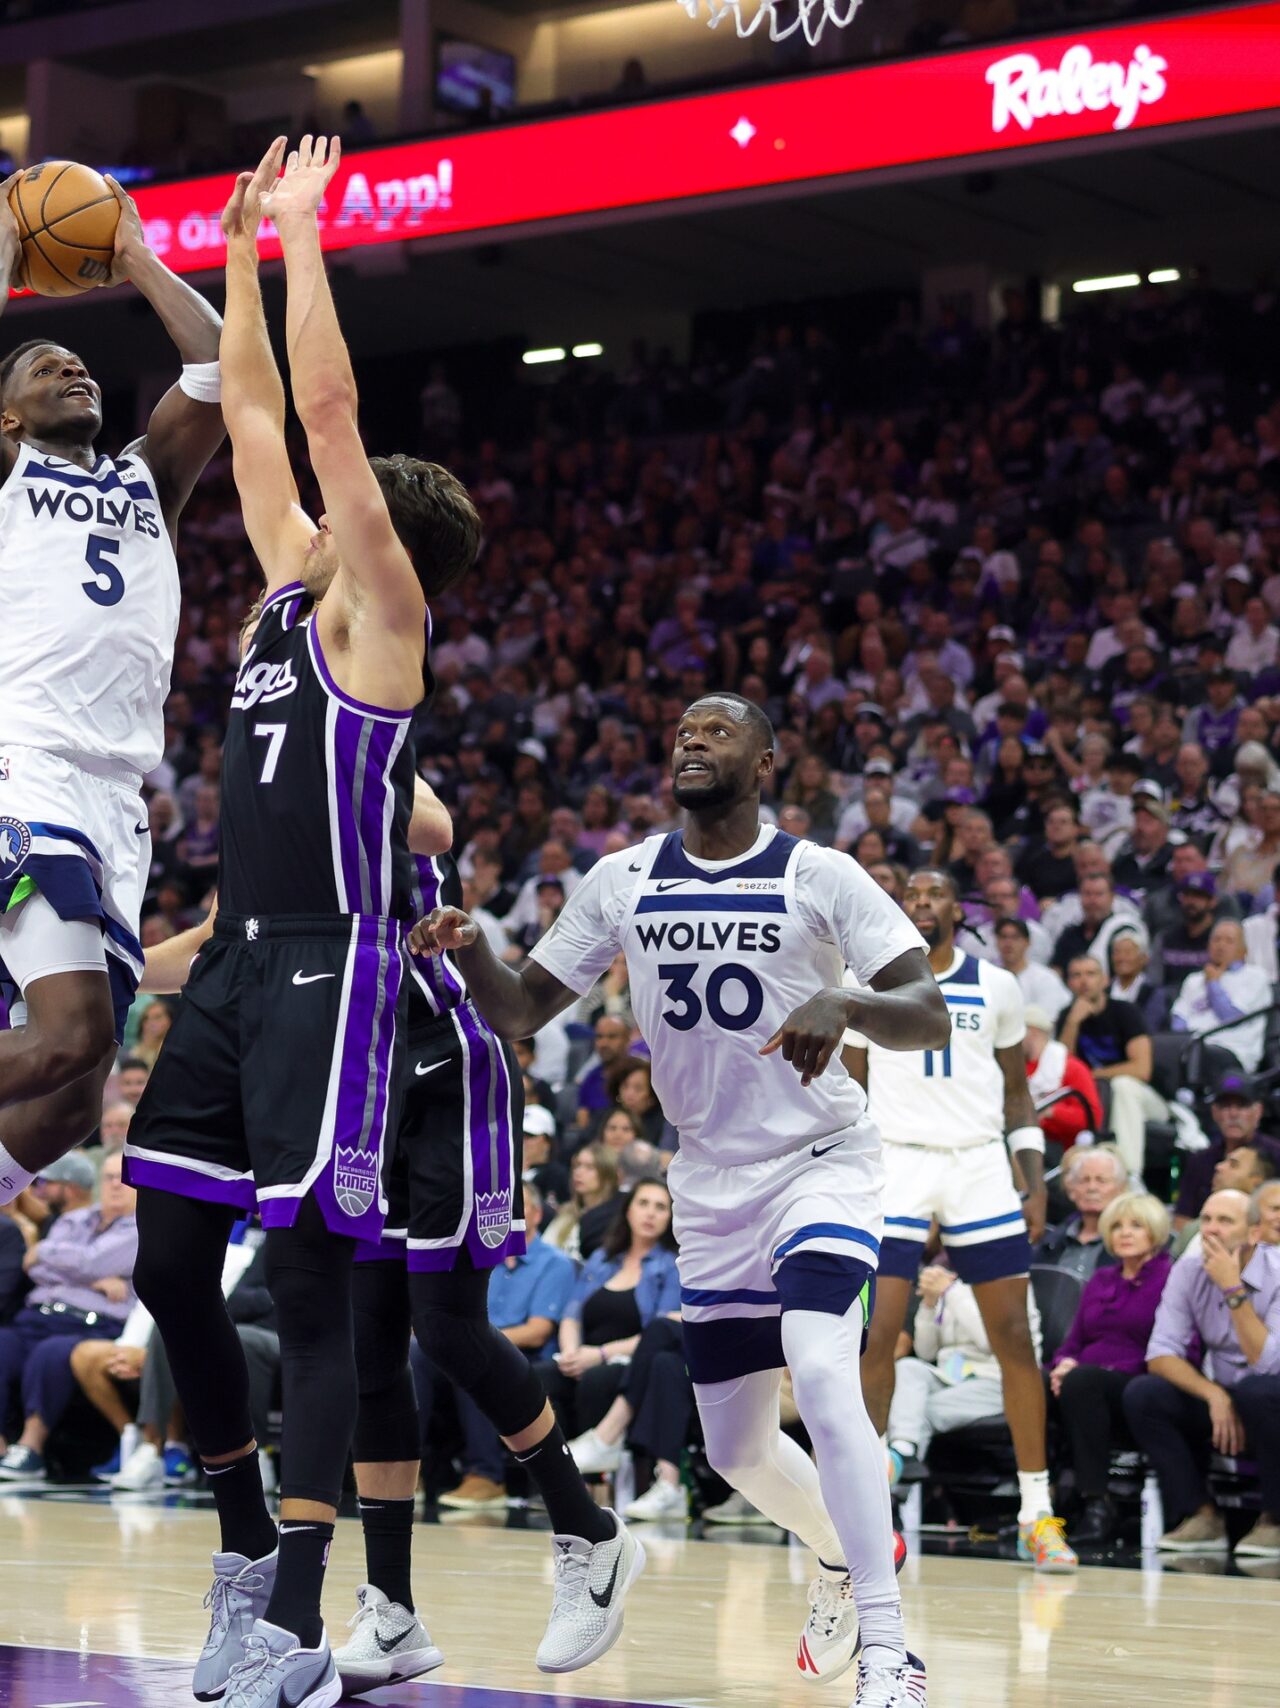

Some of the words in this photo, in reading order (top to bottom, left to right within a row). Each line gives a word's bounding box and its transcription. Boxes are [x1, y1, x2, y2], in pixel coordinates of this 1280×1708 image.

[985, 44, 1168, 132] Raley's
[333, 157, 454, 232] App!
[27, 488, 160, 539] WOLVES
[81, 533, 126, 607] 5
[254, 723, 288, 783] 7
[744, 882, 778, 890] sezzle
[635, 922, 782, 953] WOLVES
[657, 962, 764, 1031] 30
[336, 1173, 376, 1193] KINGS
[479, 1212, 510, 1228] KINGS
